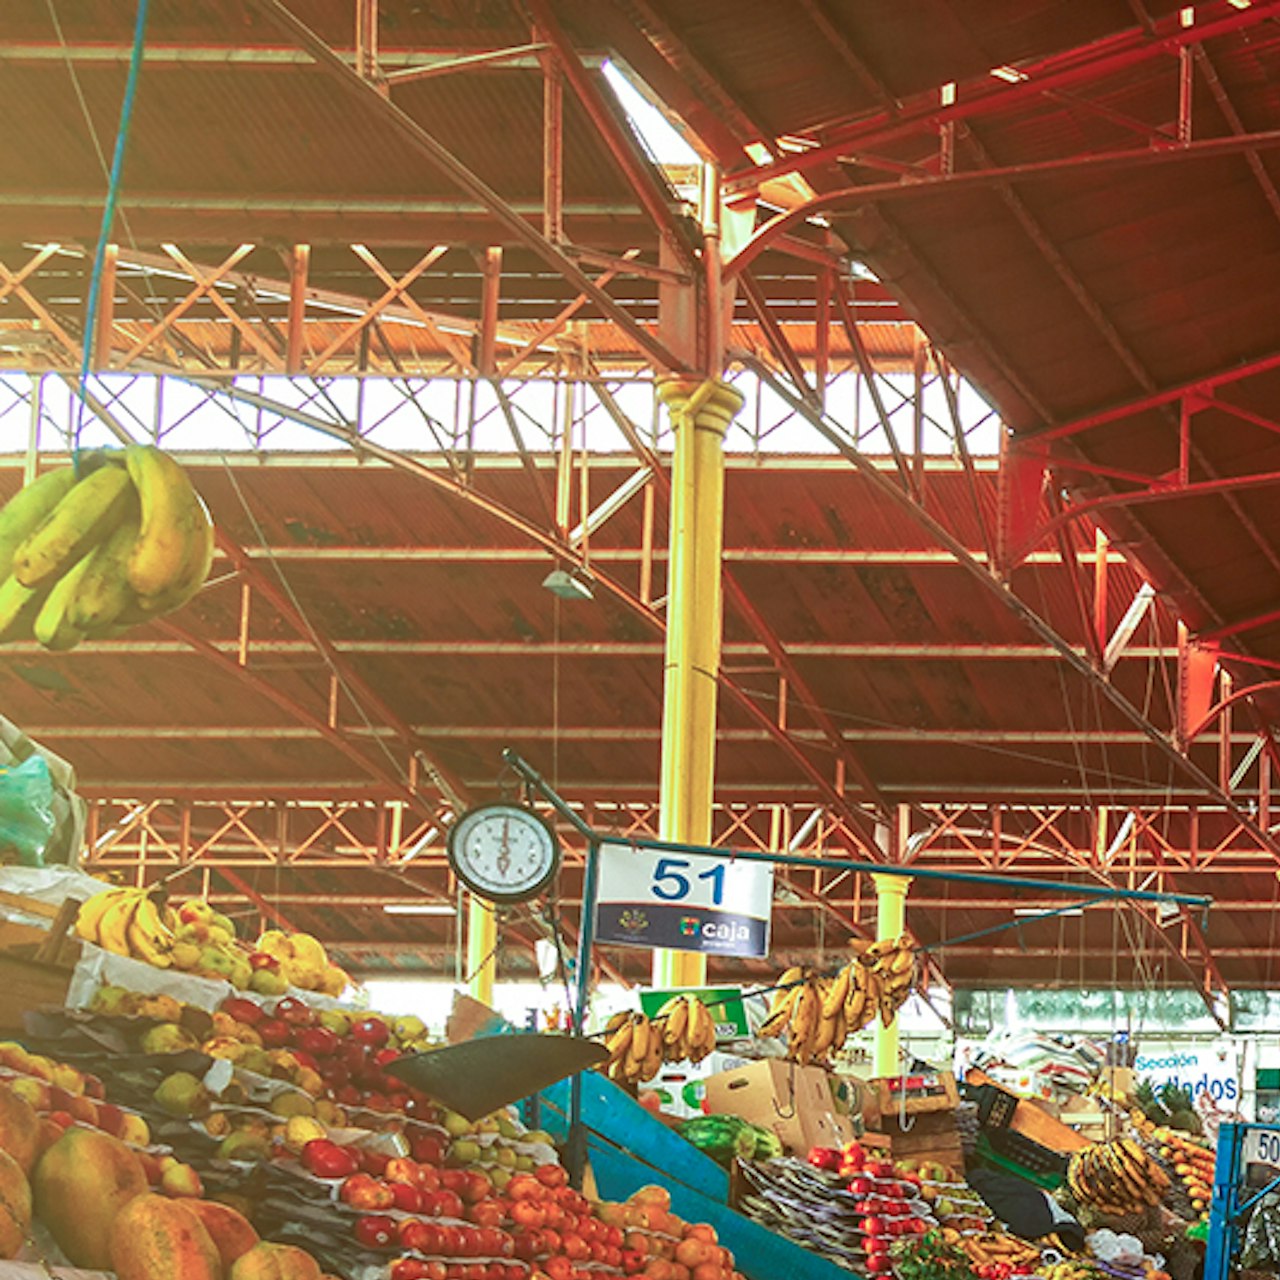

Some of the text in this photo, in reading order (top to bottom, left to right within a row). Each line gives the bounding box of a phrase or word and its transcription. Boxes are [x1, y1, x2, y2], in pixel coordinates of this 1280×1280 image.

[652, 859, 725, 905] 51
[702, 921, 750, 942] caja
[1135, 1052, 1199, 1071] Sección
[1258, 1133, 1280, 1163] 50
